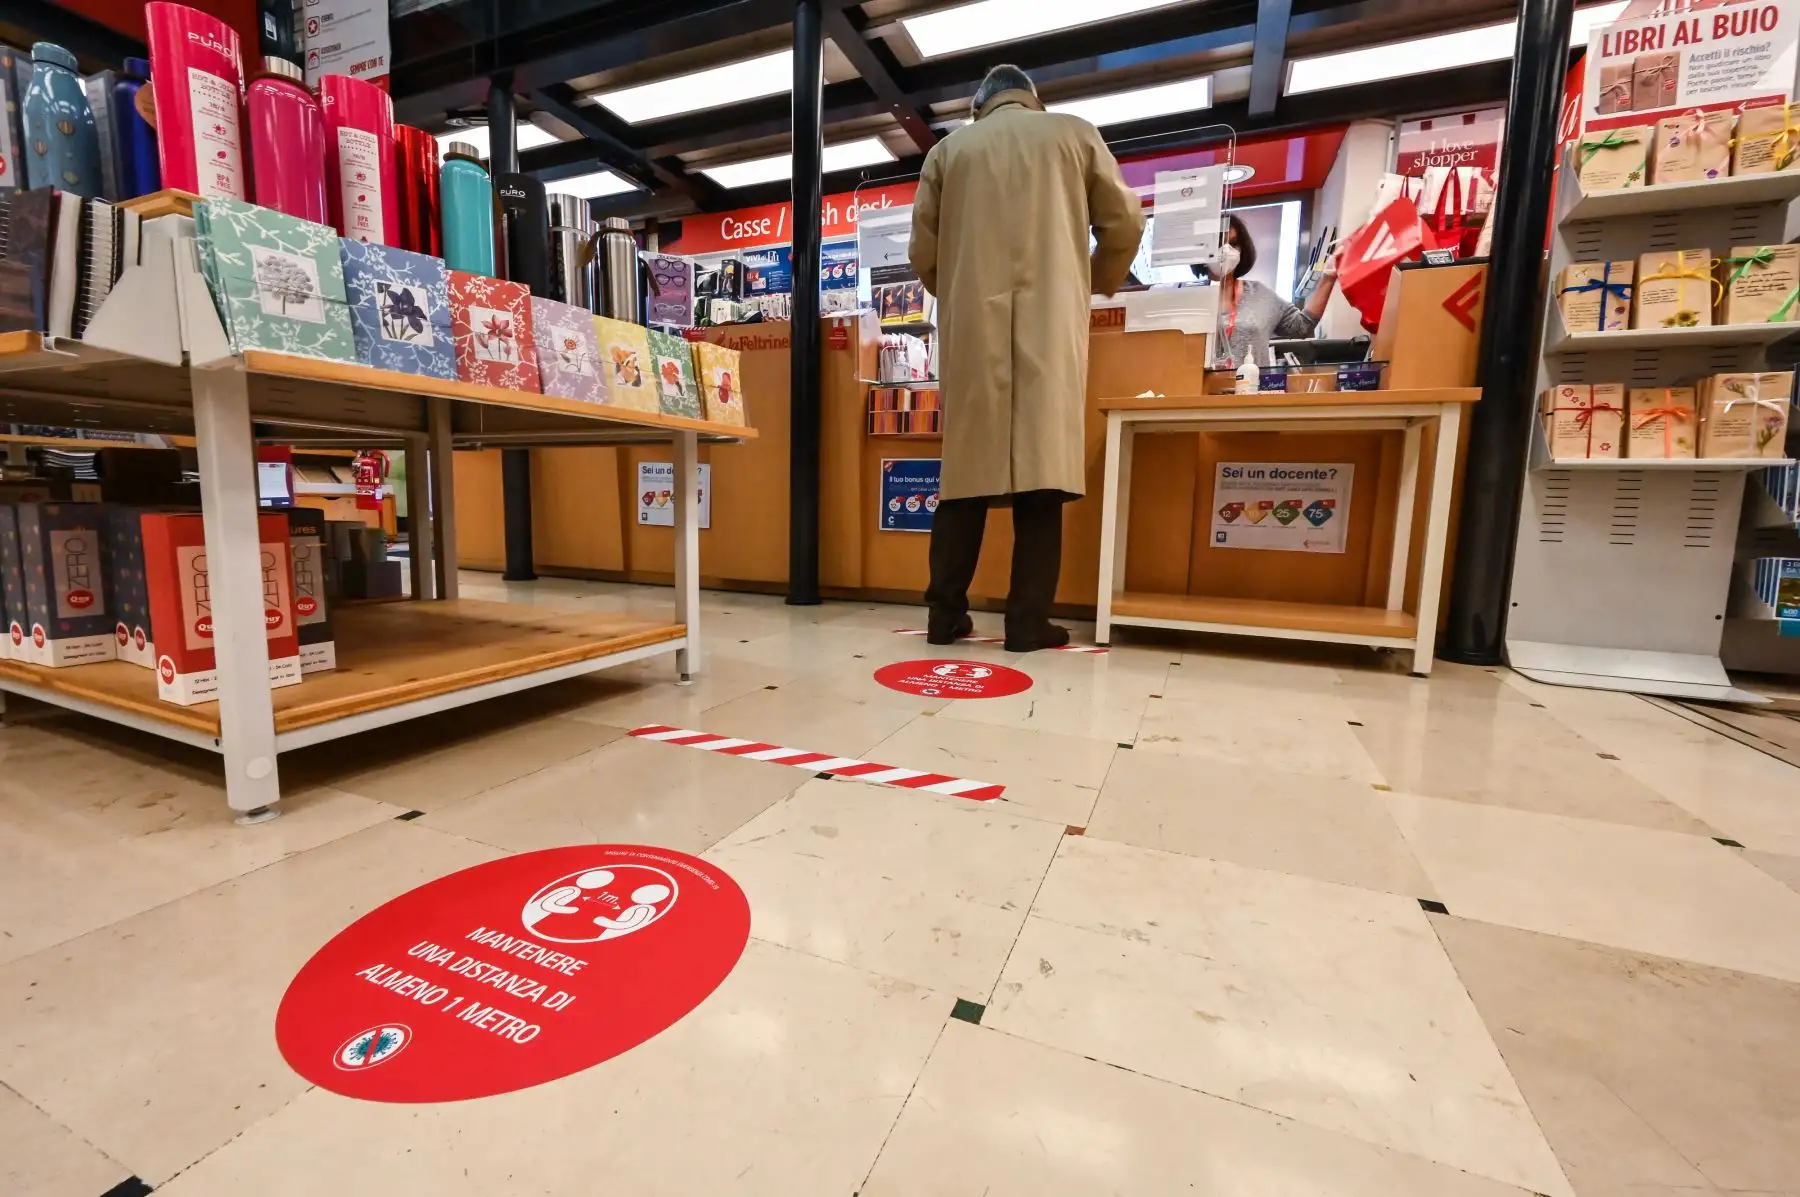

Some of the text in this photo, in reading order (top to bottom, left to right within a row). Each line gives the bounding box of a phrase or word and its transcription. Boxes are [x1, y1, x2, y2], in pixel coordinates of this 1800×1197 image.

[1602, 24, 1666, 57] LIBRI
[1672, 18, 1703, 46] AL
[1712, 5, 1778, 40] BUIO
[187, 32, 233, 57] PURO
[1689, 41, 1771, 63] Accetti il rischio?
[1442, 137, 1475, 153] love
[1413, 150, 1478, 167] shopper
[500, 184, 526, 197] PURO
[721, 217, 771, 240] Casse
[728, 334, 789, 351] laFeltrine
[642, 466, 653, 475] Sei
[655, 467, 665, 475] un
[1222, 467, 1338, 480] Sei un docente?
[925, 476, 934, 484] qui
[907, 501, 916, 509] 25
[927, 500, 936, 508] 50
[1276, 508, 1290, 518] 25
[1308, 508, 1323, 519] 75
[291, 526, 316, 535] ures
[64, 537, 91, 590] ZERO
[292, 545, 314, 596] ZERO
[297, 603, 315, 611] Quy
[897, 680, 938, 688] ALMENO
[923, 674, 978, 684] MANTENERE
[929, 679, 972, 688] DISTANZA
[465, 926, 588, 976] MANTENERE
[407, 940, 576, 1012] UNA DISTANZA DI
[355, 963, 541, 1044] ALMENO 1 METRO
